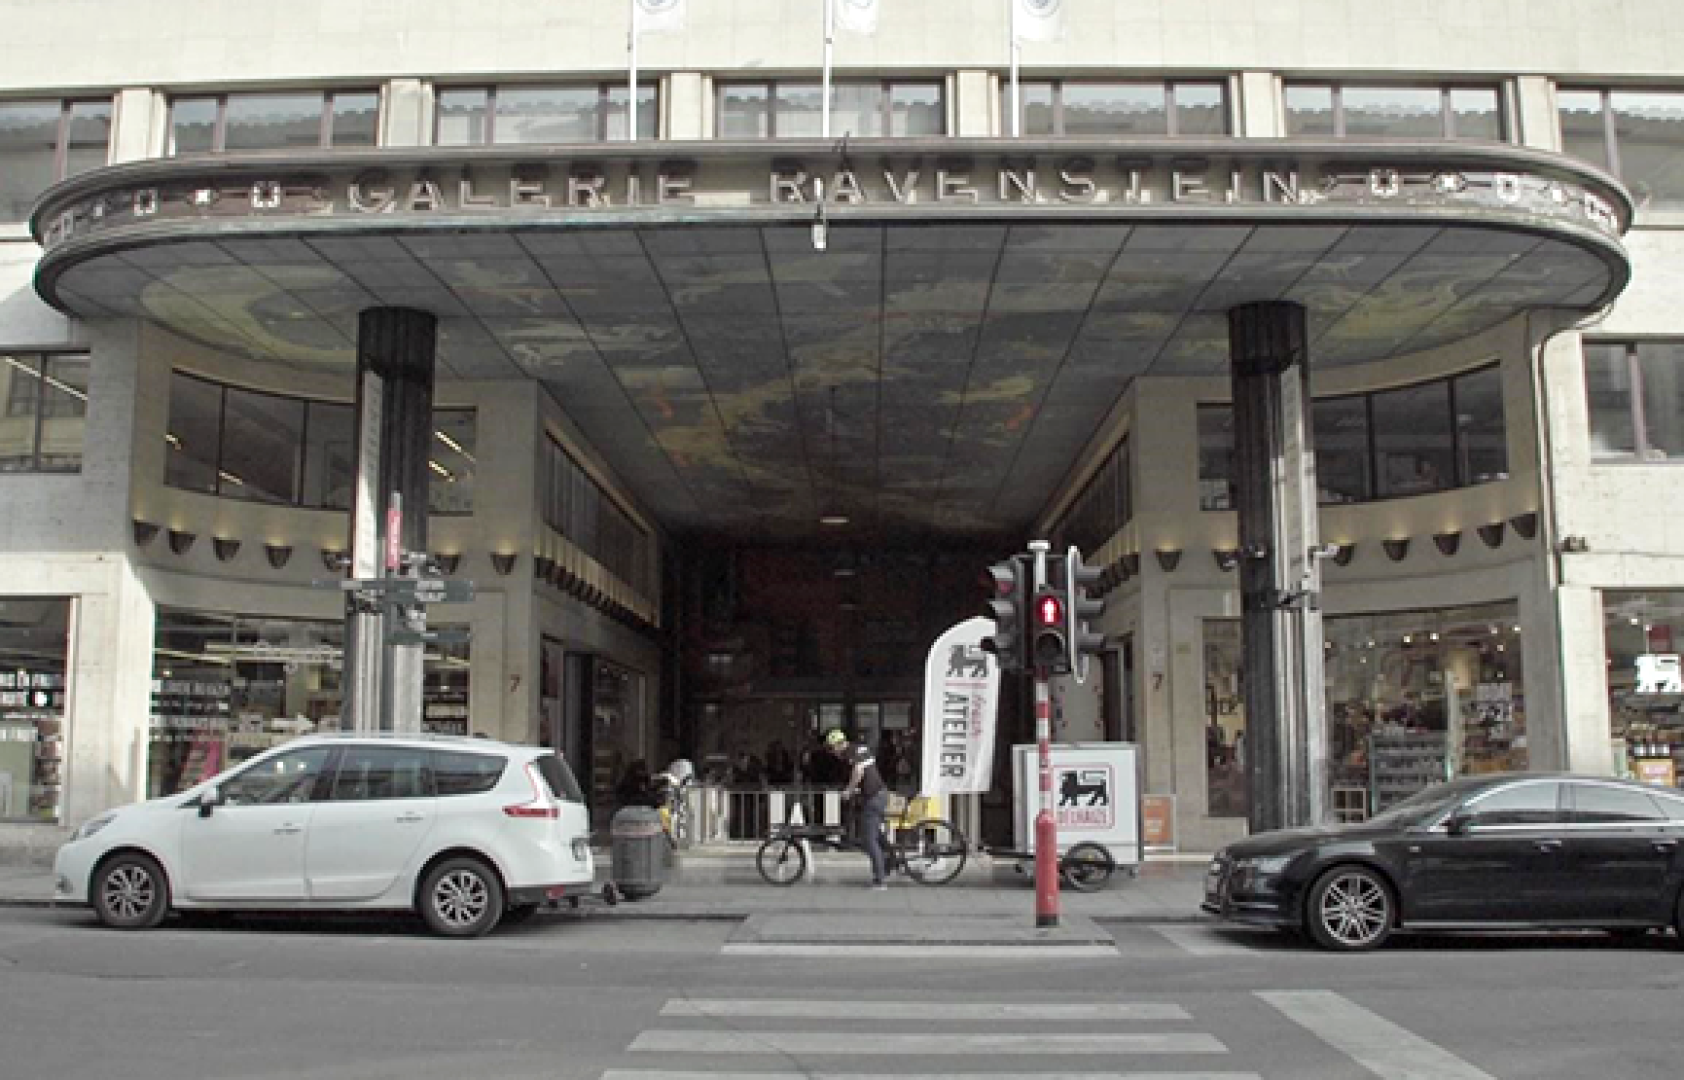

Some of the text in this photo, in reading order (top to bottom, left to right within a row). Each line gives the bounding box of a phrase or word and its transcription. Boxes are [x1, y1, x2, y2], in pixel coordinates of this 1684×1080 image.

[347, 157, 1300, 212] GALERIE RAVENSTEIN
[1152, 671, 1164, 692] 7
[939, 691, 970, 778] ATELIER
